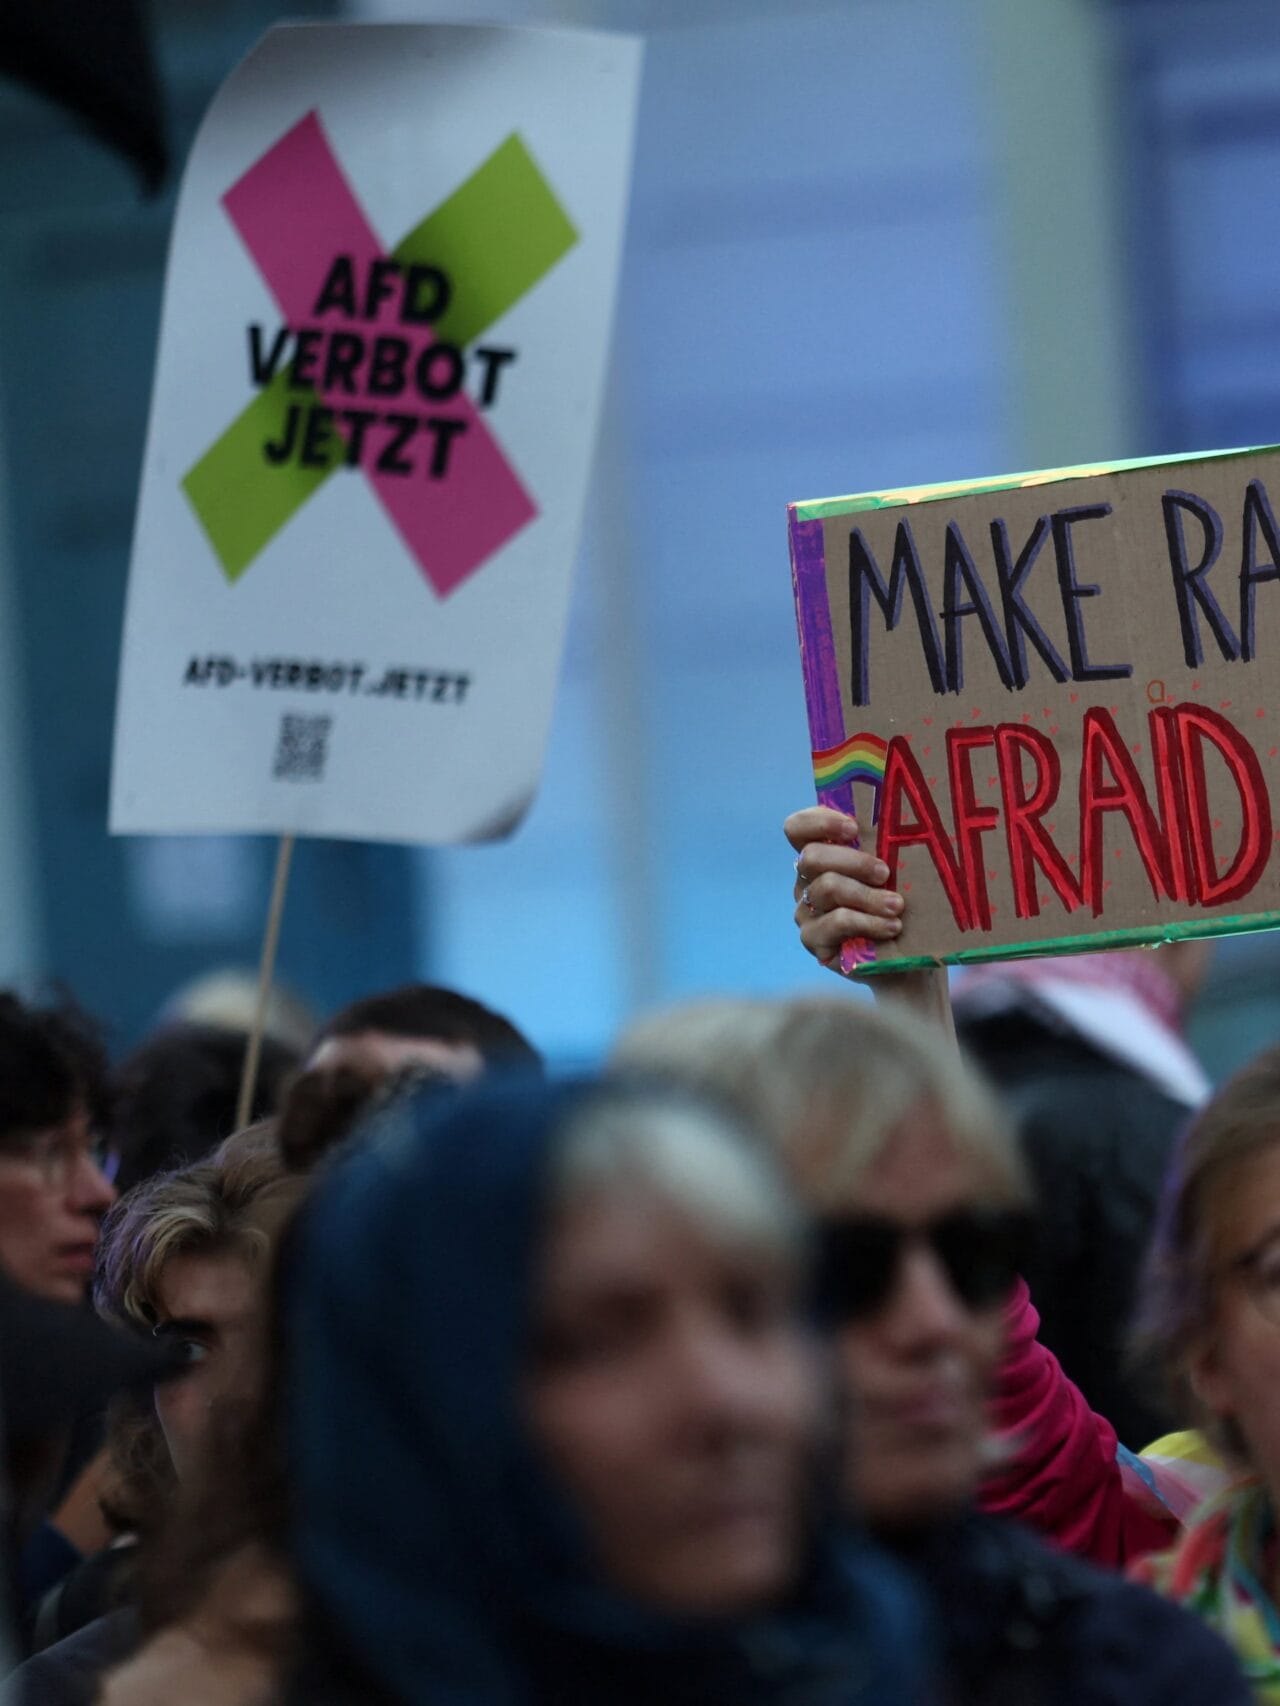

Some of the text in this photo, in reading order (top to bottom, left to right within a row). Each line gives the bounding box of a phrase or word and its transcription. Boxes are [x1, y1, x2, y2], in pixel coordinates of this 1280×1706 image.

[313, 255, 453, 325] AFD
[247, 324, 516, 409] VERBOT
[264, 405, 469, 480] JETZT
[848, 501, 1133, 707] MAKE
[183, 655, 471, 704] AFD-VERBOT.JETZT
[875, 701, 1273, 932] AFRAID
